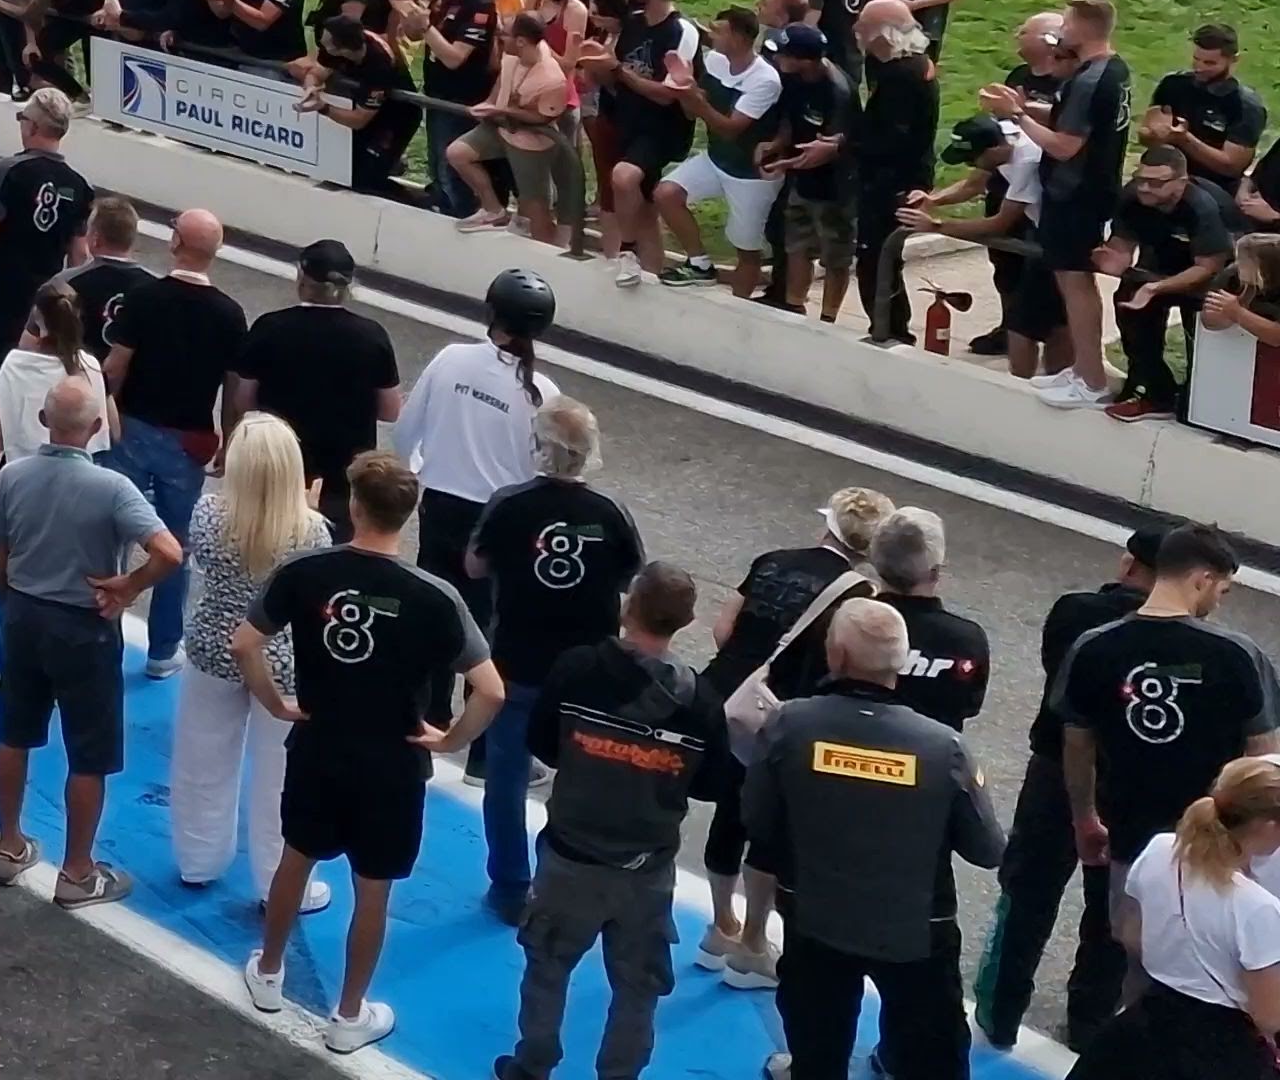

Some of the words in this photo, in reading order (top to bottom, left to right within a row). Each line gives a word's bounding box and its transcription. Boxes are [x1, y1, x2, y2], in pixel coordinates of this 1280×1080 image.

[175, 99, 224, 128] PAUL
[231, 114, 304, 149] RICARD
[454, 382, 471, 396] PIT
[534, 521, 586, 589] 8
[323, 588, 376, 664] 8
[898, 649, 955, 678] hr
[1124, 661, 1185, 744] 8
[823, 748, 907, 778] PIRELLI
